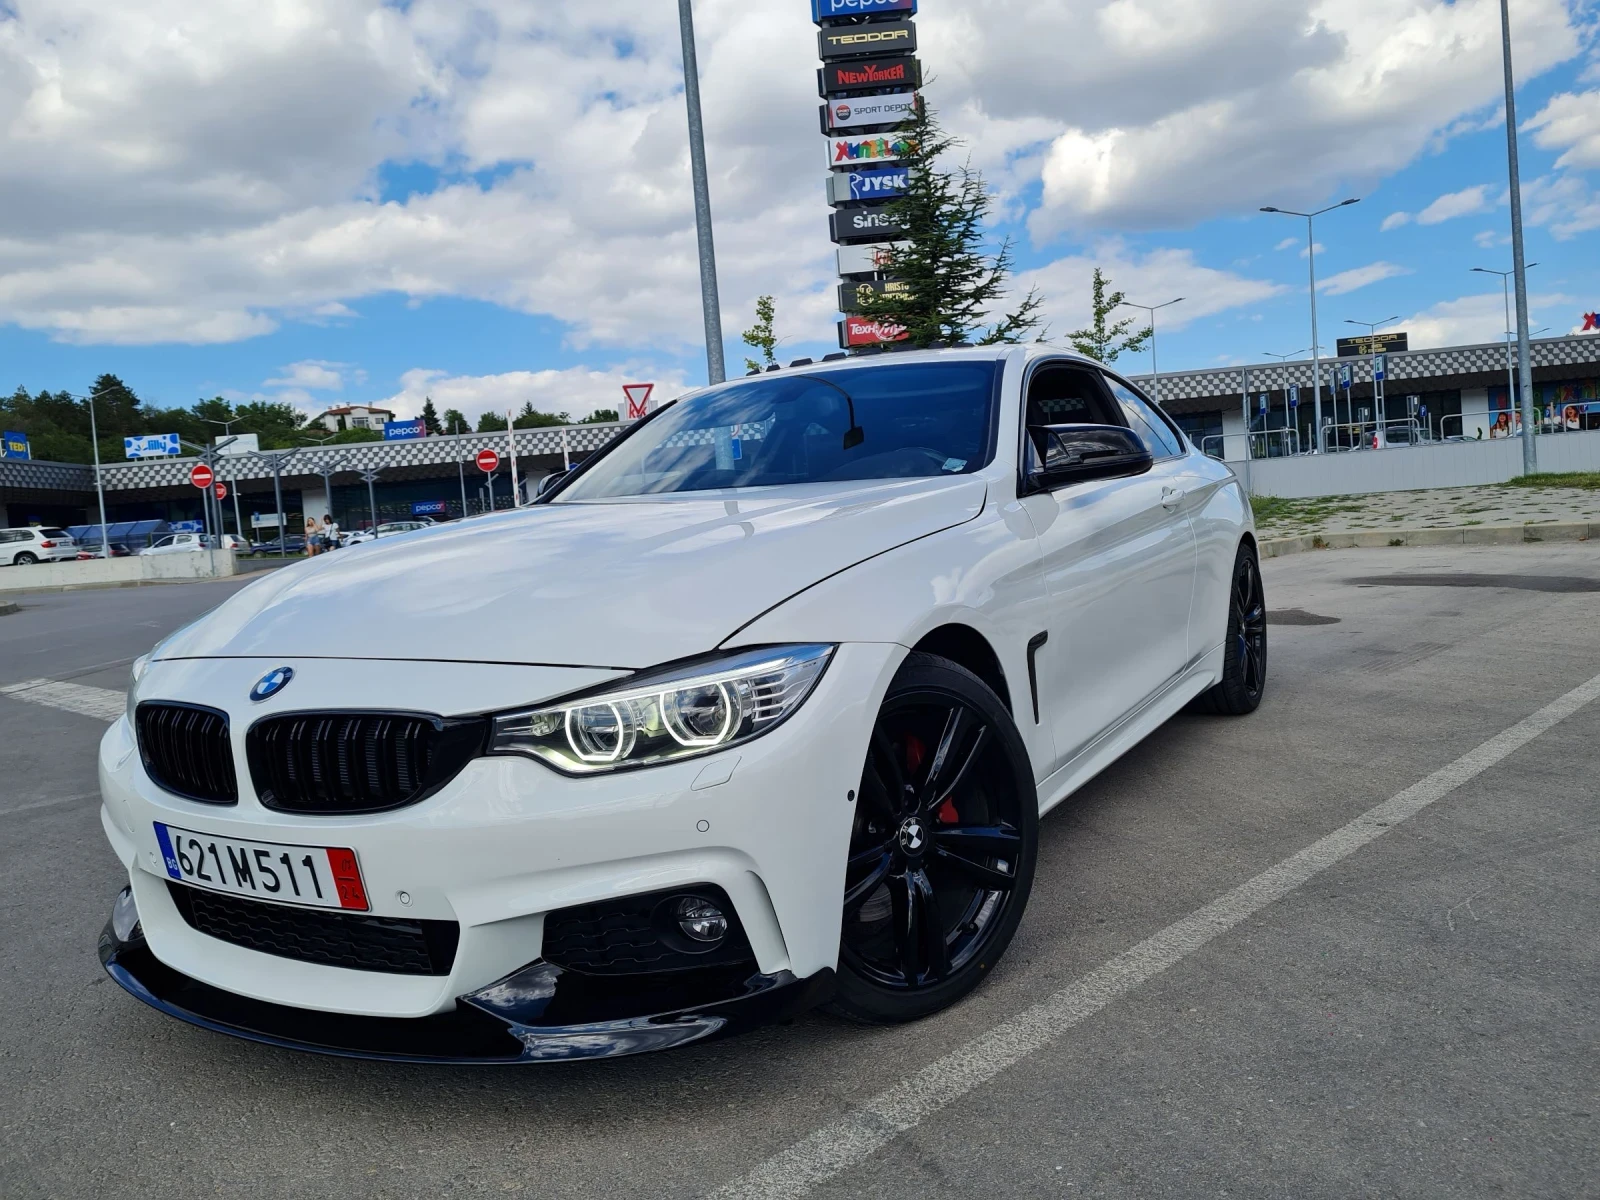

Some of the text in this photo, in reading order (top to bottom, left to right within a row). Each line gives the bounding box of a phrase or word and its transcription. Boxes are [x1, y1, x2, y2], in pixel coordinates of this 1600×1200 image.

[831, 0, 899, 12] pep
[827, 29, 909, 45] TEODOR
[854, 103, 911, 115] SPORT DEPOT
[862, 174, 907, 192] JYSK
[1347, 334, 1398, 344] TEODOR
[629, 404, 647, 419] kk
[388, 426, 421, 437] pepco
[8, 442, 26, 452] TEDi
[148, 439, 167, 452] lilly
[415, 504, 441, 513] pepco
[166, 835, 323, 899] BG 621M511
